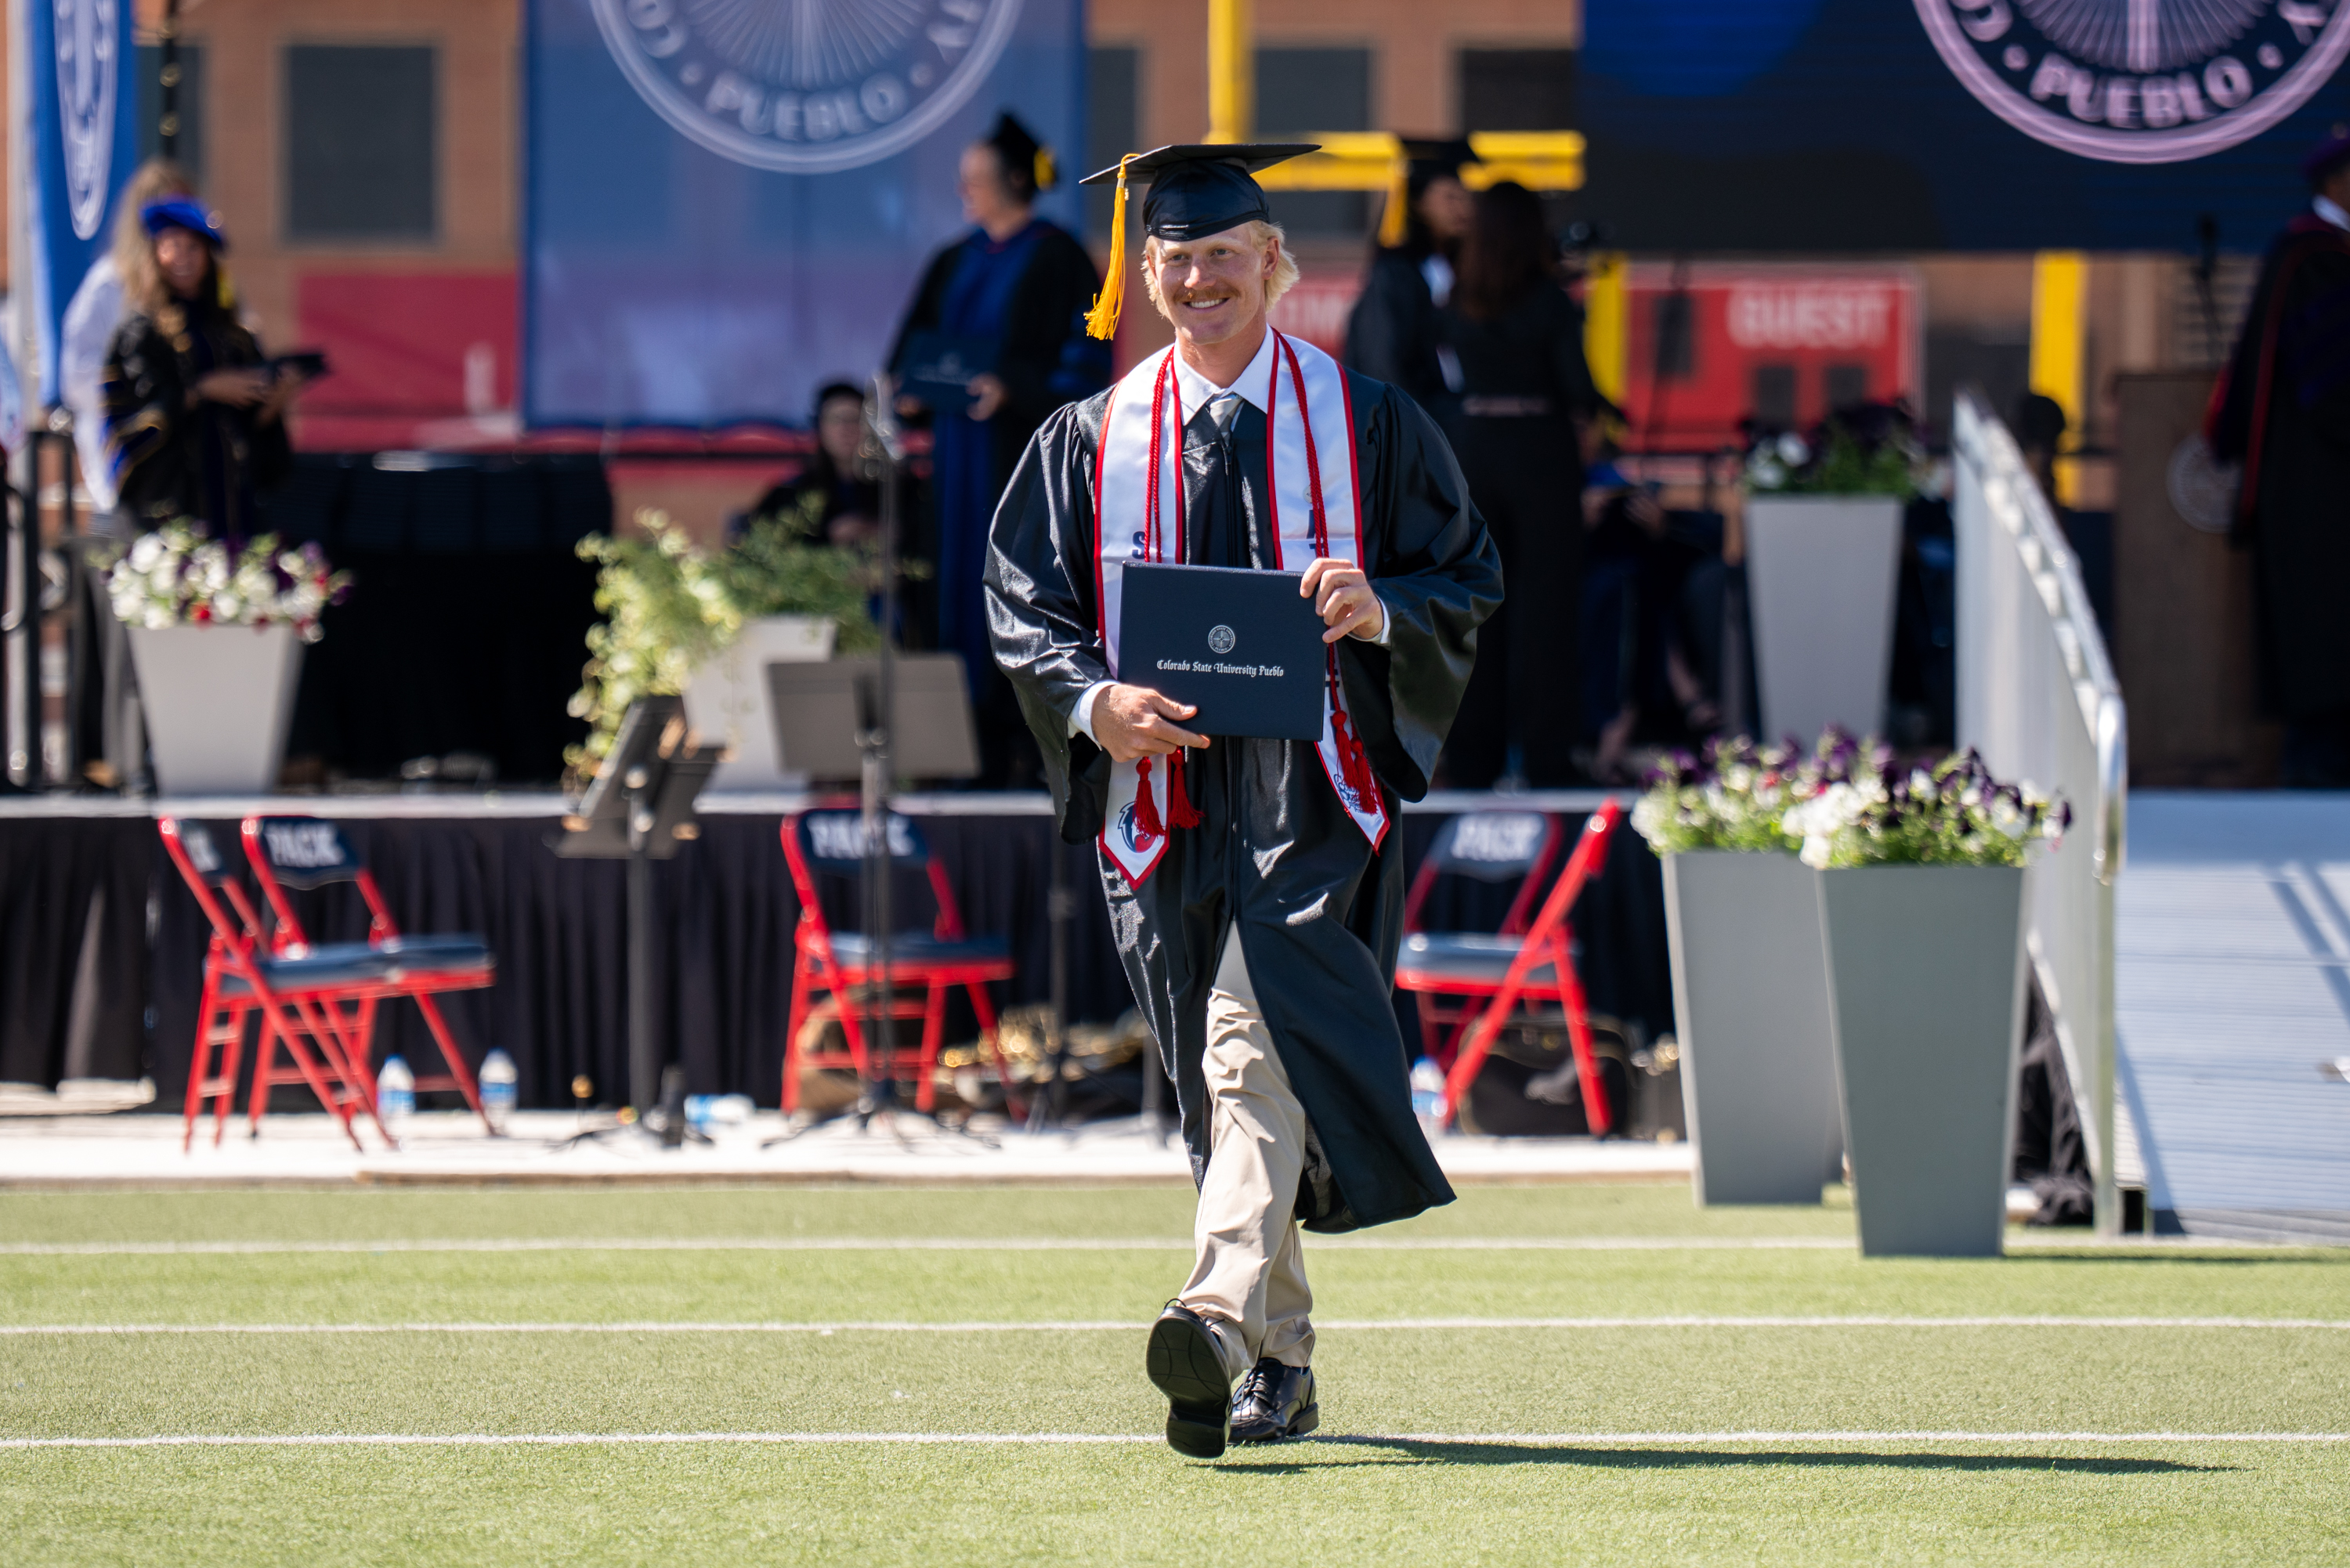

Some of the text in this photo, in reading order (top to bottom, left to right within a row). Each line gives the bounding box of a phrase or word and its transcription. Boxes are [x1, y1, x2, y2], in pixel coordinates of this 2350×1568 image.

[710, 74, 907, 141] PUEBLO
[2030, 52, 2253, 128] PUEBLO
[1726, 285, 1888, 348] GUEST
[1156, 659, 1284, 678] Colorado State University Pueblo
[265, 822, 346, 867] PACK
